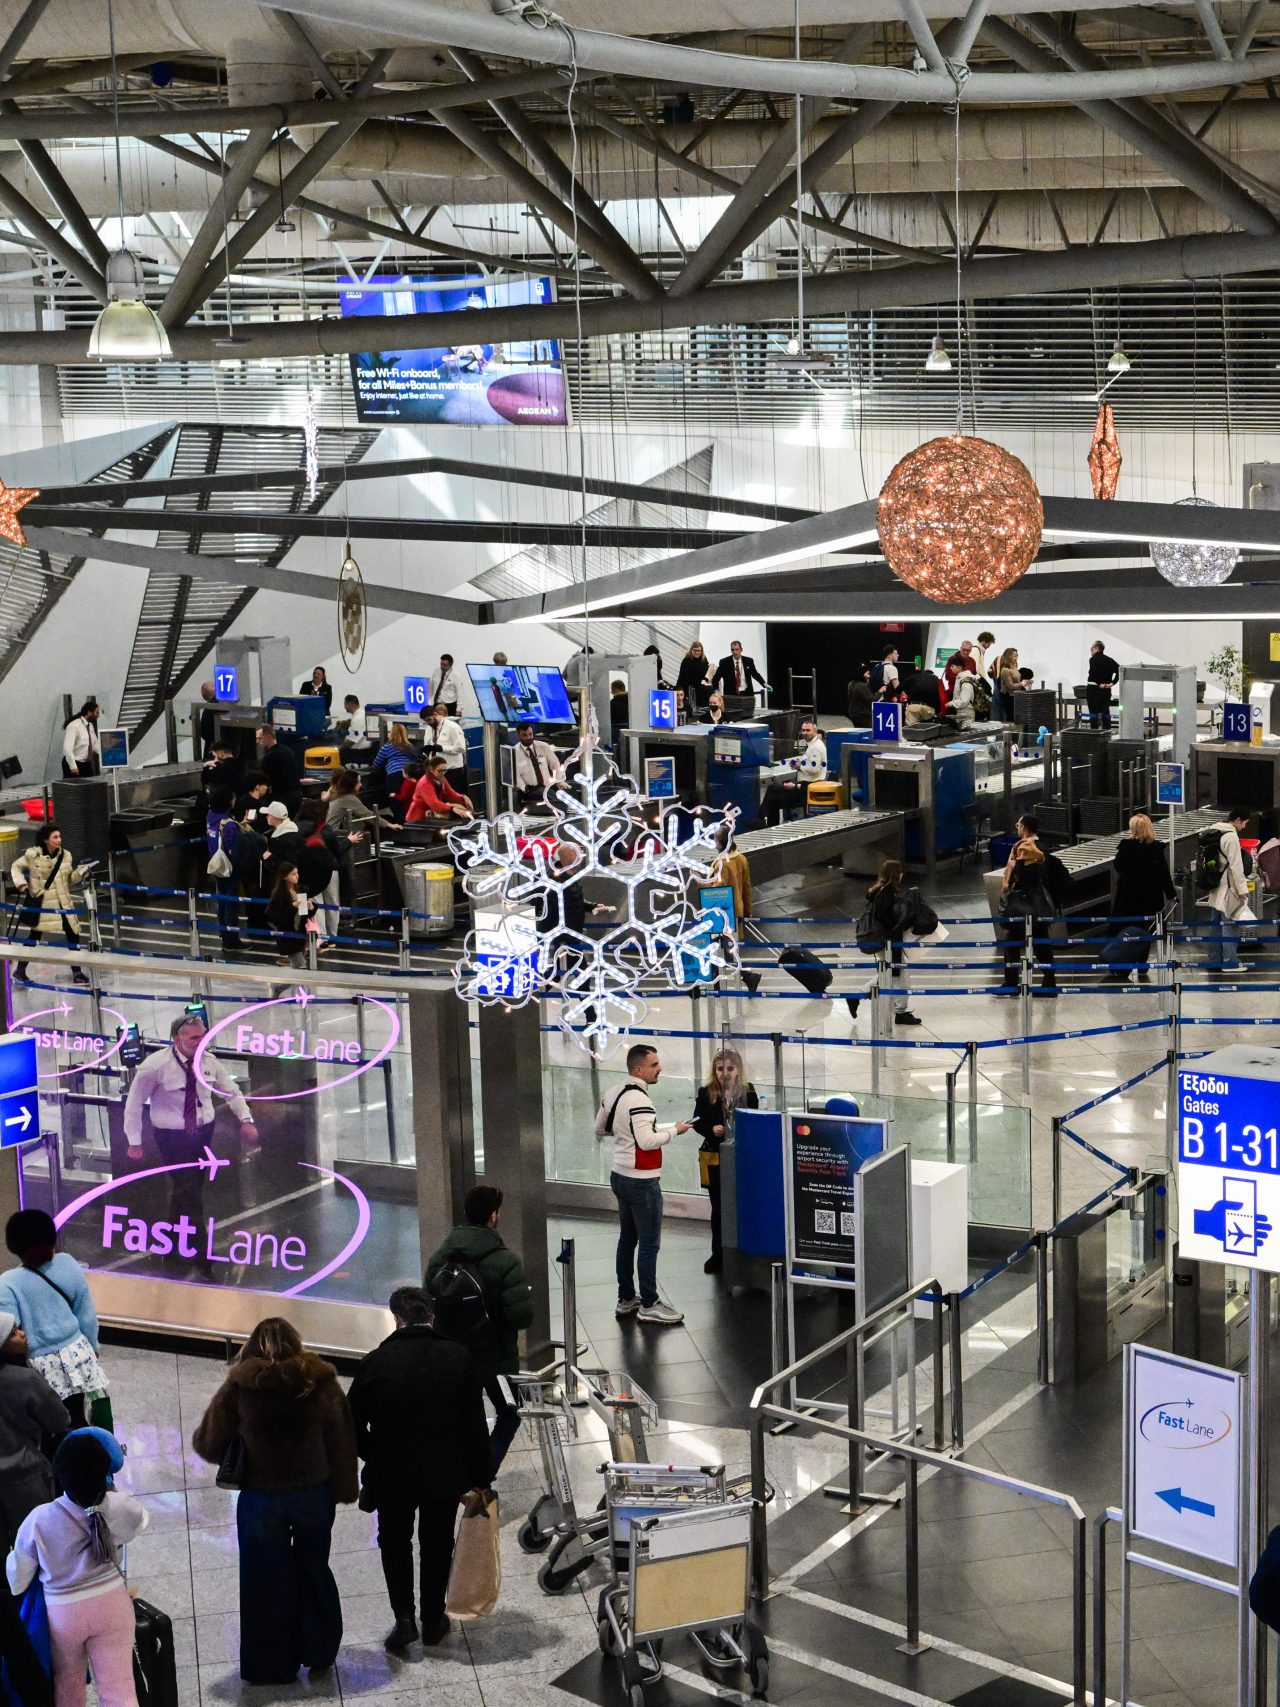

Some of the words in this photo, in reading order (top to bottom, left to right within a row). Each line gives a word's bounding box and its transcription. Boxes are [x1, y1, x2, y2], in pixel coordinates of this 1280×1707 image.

[356, 367, 375, 378] Free
[376, 367, 400, 378] Wi-Fi
[400, 368, 440, 379] onboard,
[358, 380, 370, 390] for
[371, 380, 383, 390] all
[383, 380, 437, 390] Miles+Bonus
[438, 380, 483, 390] members!
[360, 392, 375, 400] Enjoy
[398, 392, 408, 400] just
[517, 407, 551, 415] AEGEAN
[217, 674, 234, 692] 17
[407, 685, 425, 704] 16
[652, 699, 671, 719] 15
[876, 712, 896, 732] 14
[1227, 713, 1247, 733] 13
[64, 1030, 104, 1053] Lane
[236, 1025, 295, 1058] Fast
[300, 1027, 362, 1063] Lane
[1178, 1073, 1229, 1096] Έξοδοι
[1183, 1095, 1220, 1116] Gates
[1183, 1116, 1205, 1159] B
[1214, 1121, 1277, 1169] 1-31
[102, 1204, 198, 1259] Fast
[207, 1216, 307, 1271] Lane
[1158, 1410, 1185, 1430] Fast
[1186, 1419, 1214, 1439] Lane
